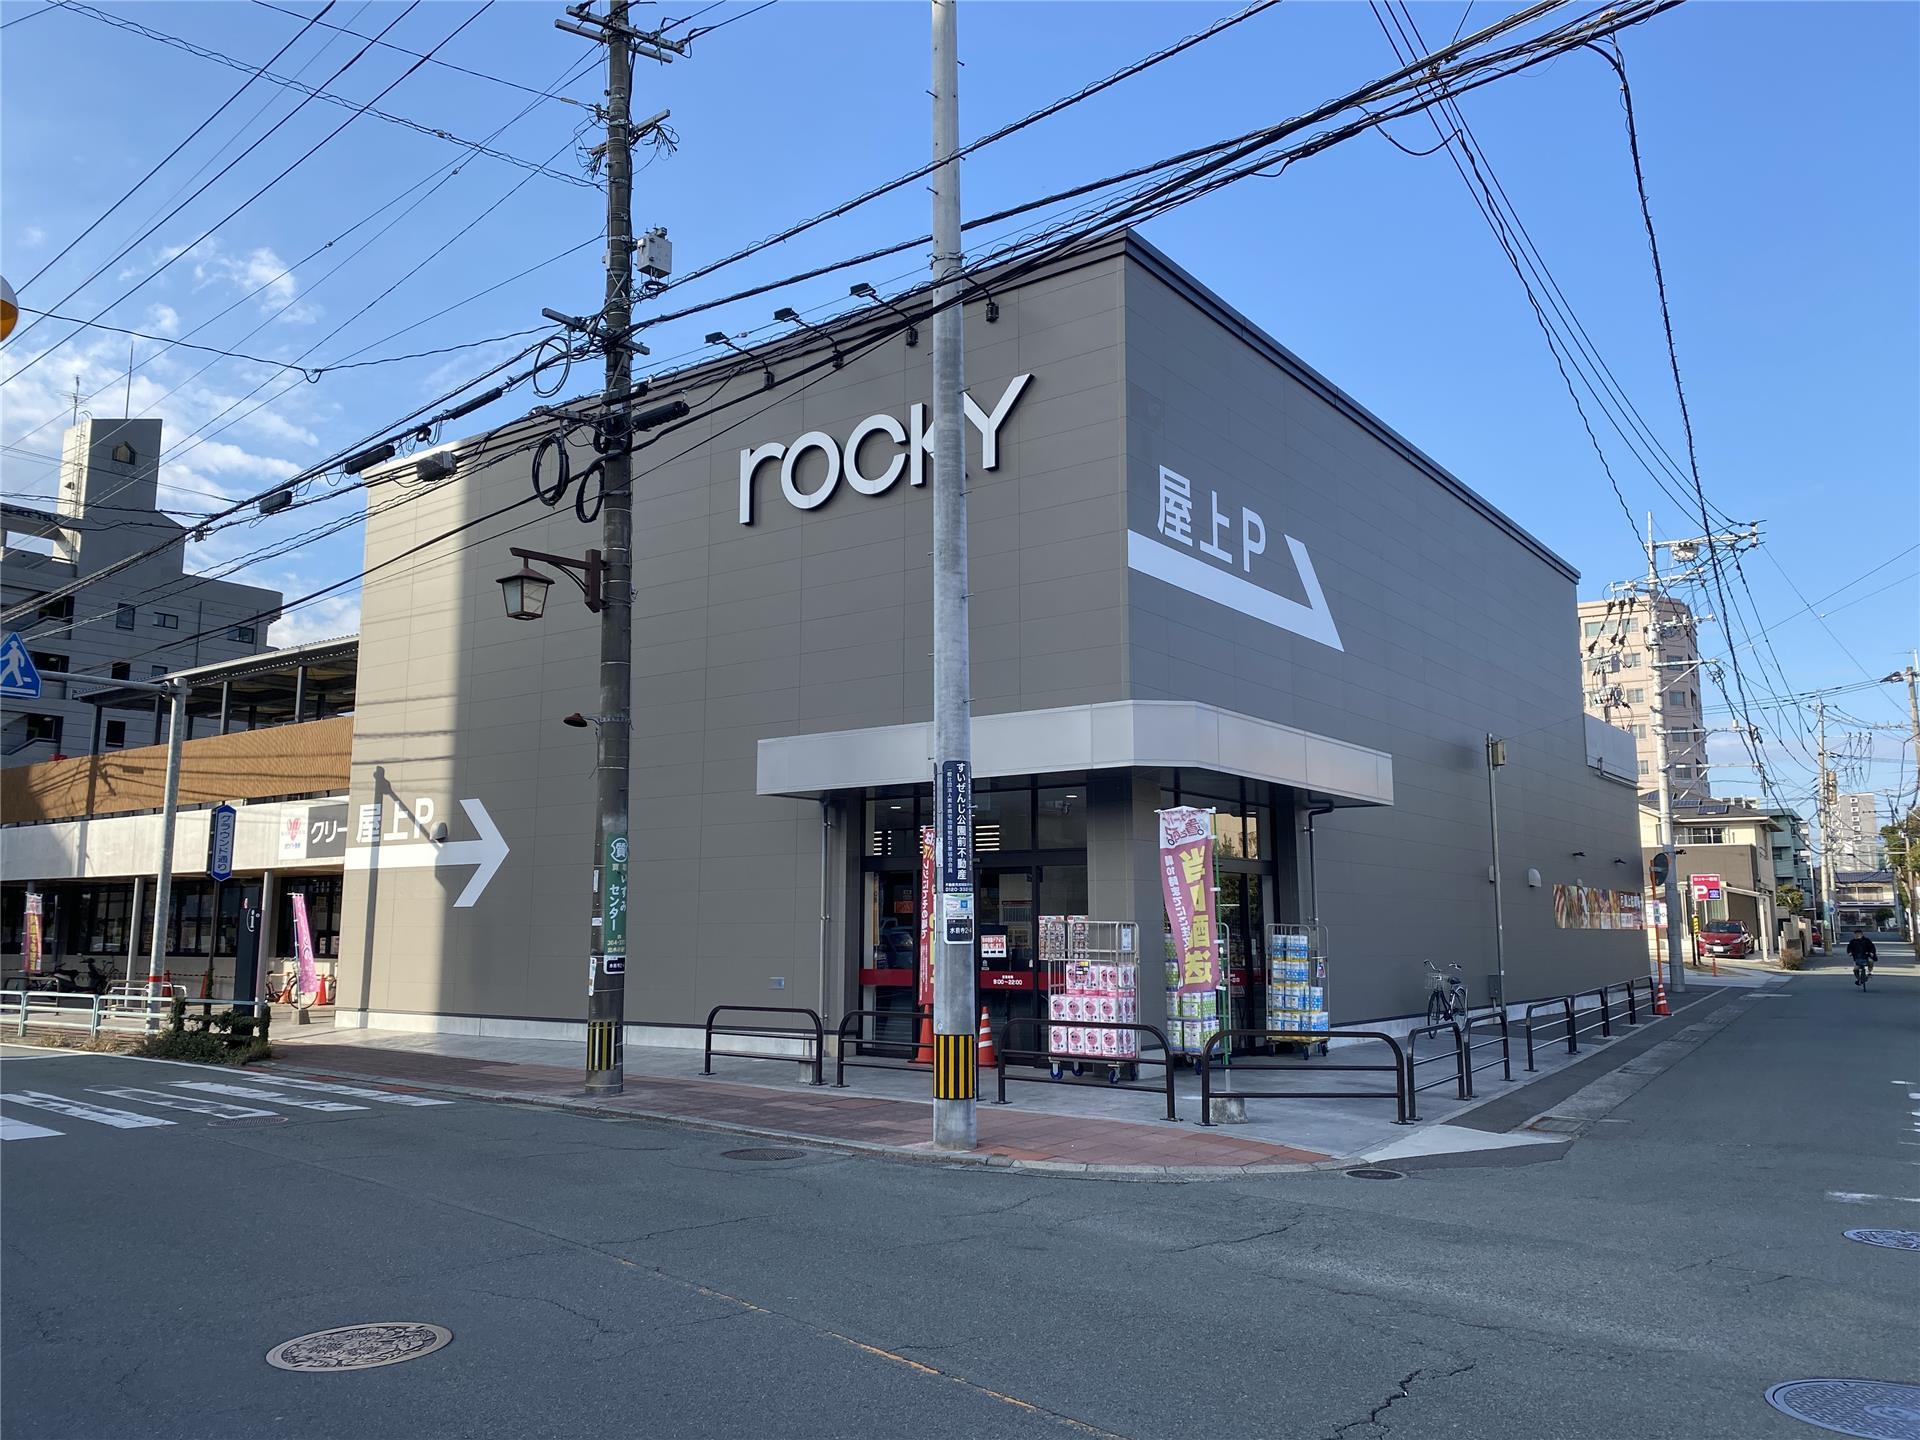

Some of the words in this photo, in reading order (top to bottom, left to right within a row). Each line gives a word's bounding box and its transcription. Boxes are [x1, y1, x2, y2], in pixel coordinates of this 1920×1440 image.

[1157, 464, 1266, 573] 屋上P
[356, 797, 434, 844] 屋上P
[956, 762, 967, 880] すいぜんじ公園前不動産
[609, 883, 620, 931] センター
[1694, 885, 1708, 899] P
